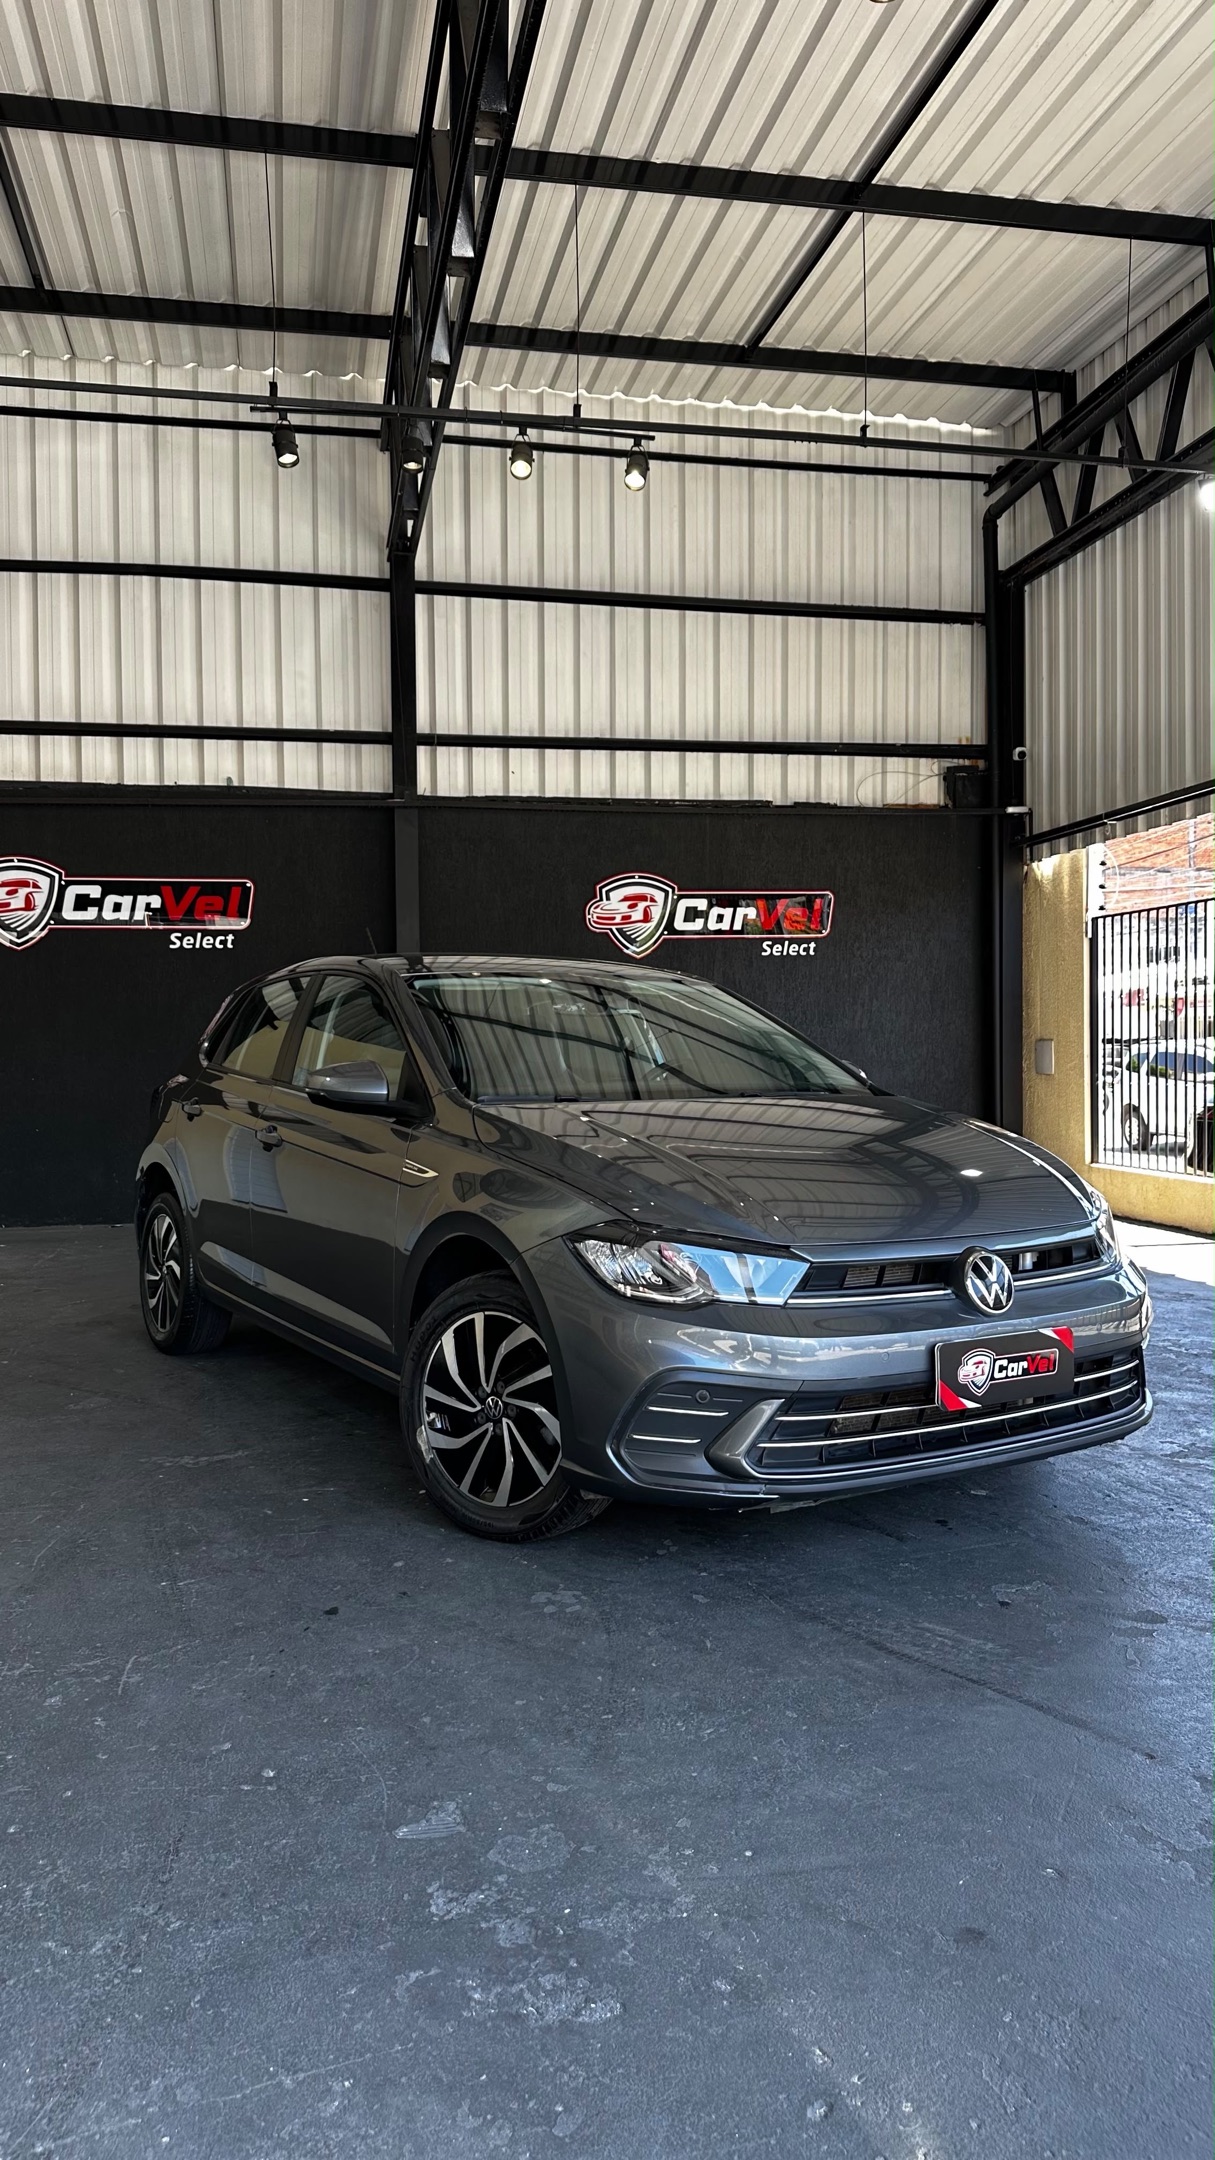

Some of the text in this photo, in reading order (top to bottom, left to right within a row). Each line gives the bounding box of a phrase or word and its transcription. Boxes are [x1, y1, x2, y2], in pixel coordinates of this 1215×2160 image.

[61, 884, 242, 921] CarVel
[673, 898, 823, 931] CarVel
[169, 931, 235, 949] Select
[761, 940, 817, 956] Select
[993, 1353, 1055, 1379] CarVel
